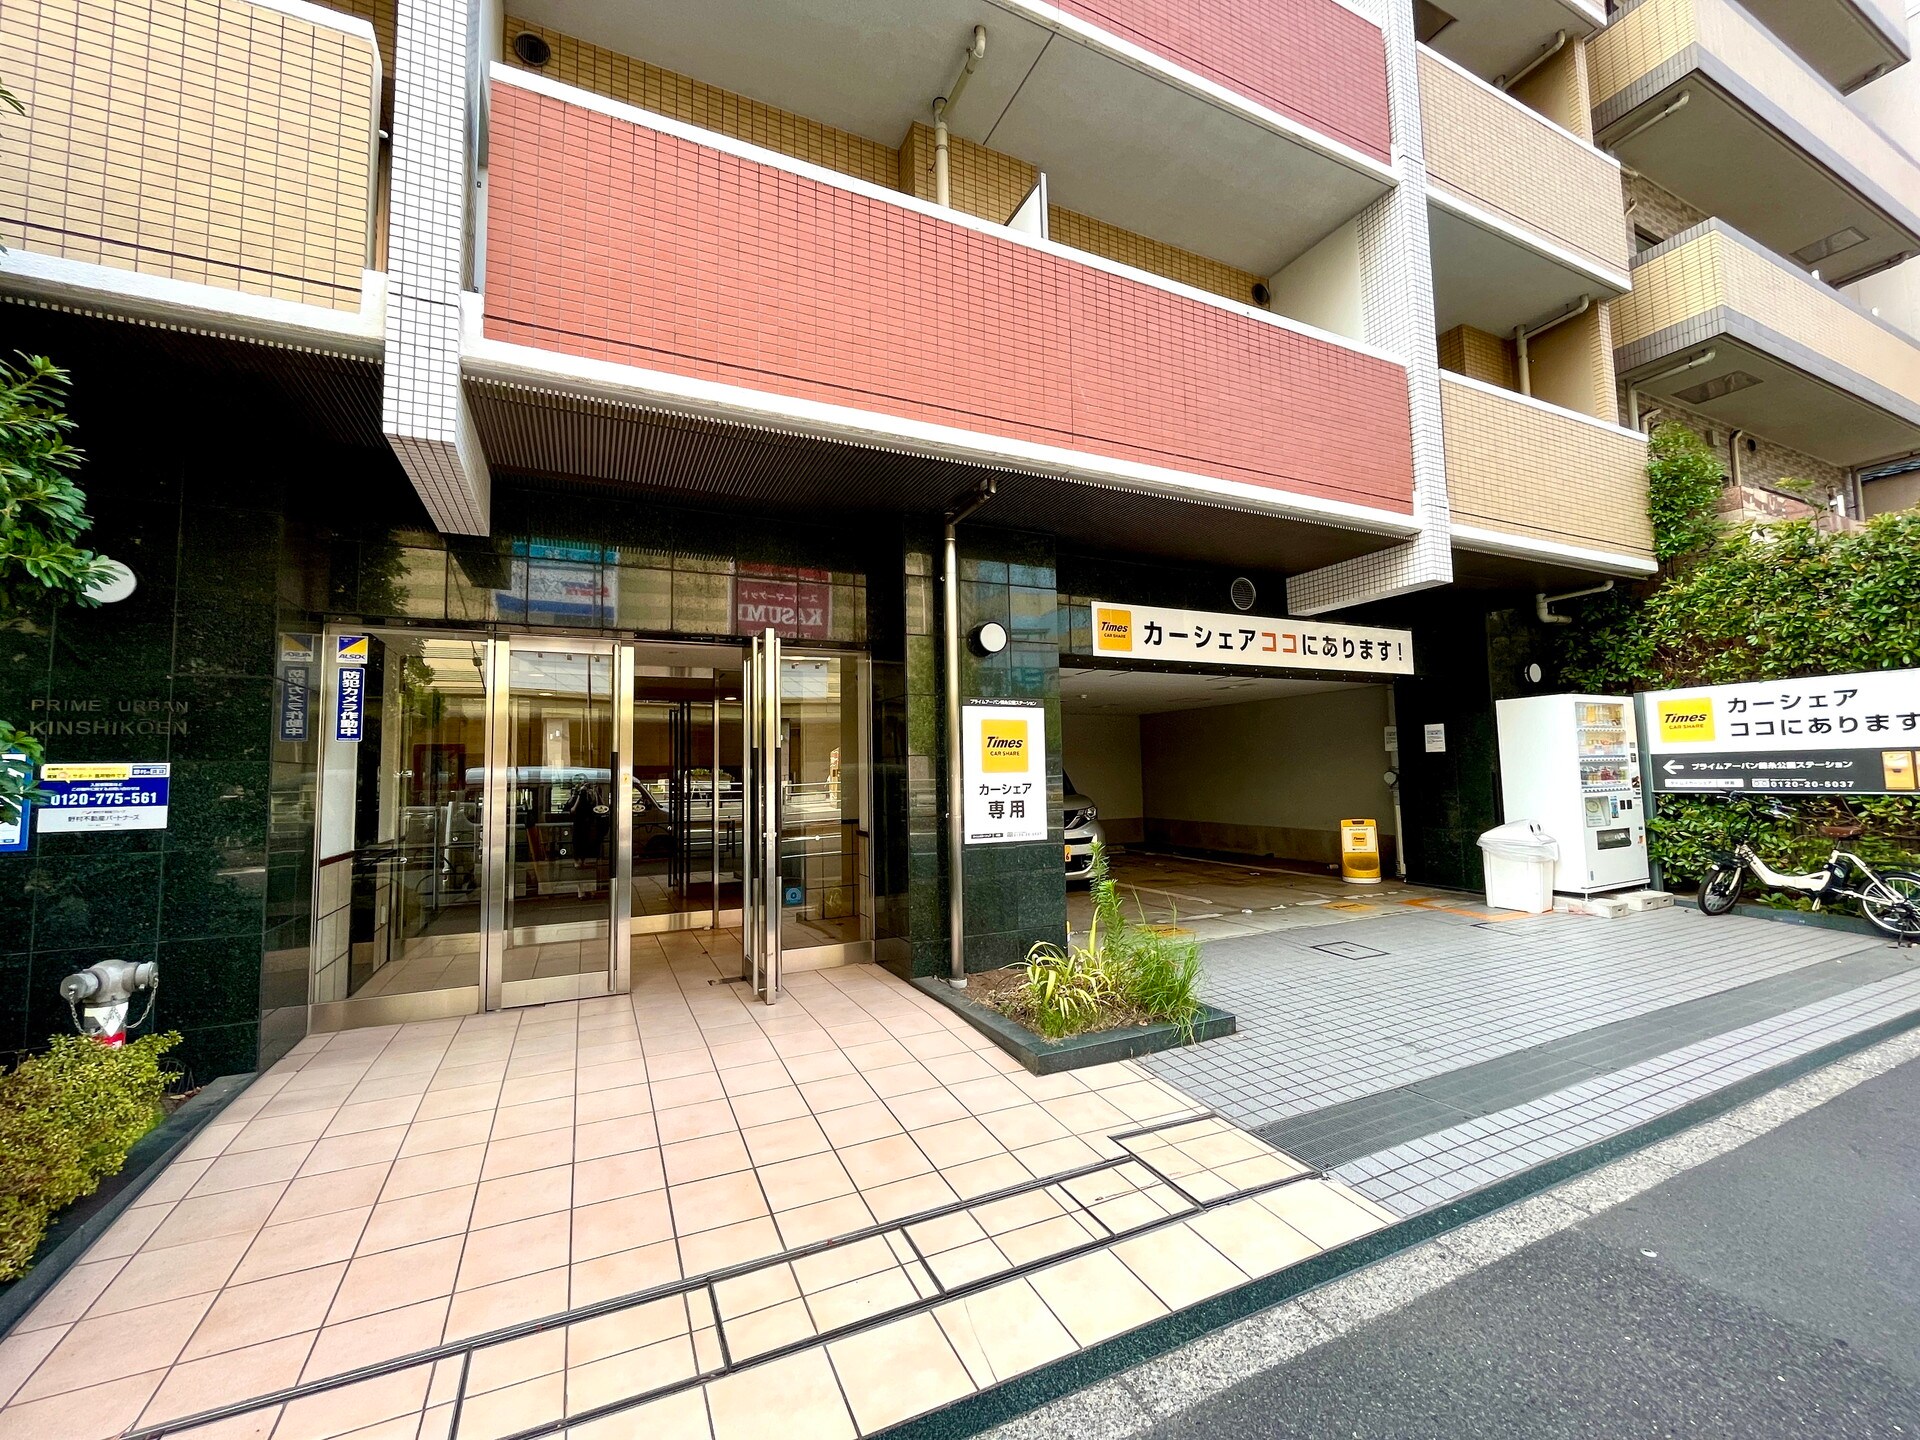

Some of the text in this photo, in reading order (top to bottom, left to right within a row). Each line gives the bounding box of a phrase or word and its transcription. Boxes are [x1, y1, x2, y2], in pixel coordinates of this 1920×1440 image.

[1101, 621, 1129, 633] Times
[1143, 620, 1403, 662] カーシェアココにあります!
[31, 699, 189, 713] PRIME URBAN
[340, 670, 361, 737] 防犯カメラ作動中
[1727, 688, 1859, 714] カーシェア
[1664, 712, 1708, 724] Times
[1730, 711, 1920, 738] ココにあります
[986, 736, 1024, 749] Times
[979, 783, 1032, 796] カーシェア
[1770, 780, 1854, 788] 0120-20-5037
[50, 791, 158, 806] 0120-775-561
[988, 800, 1025, 819] 専用
